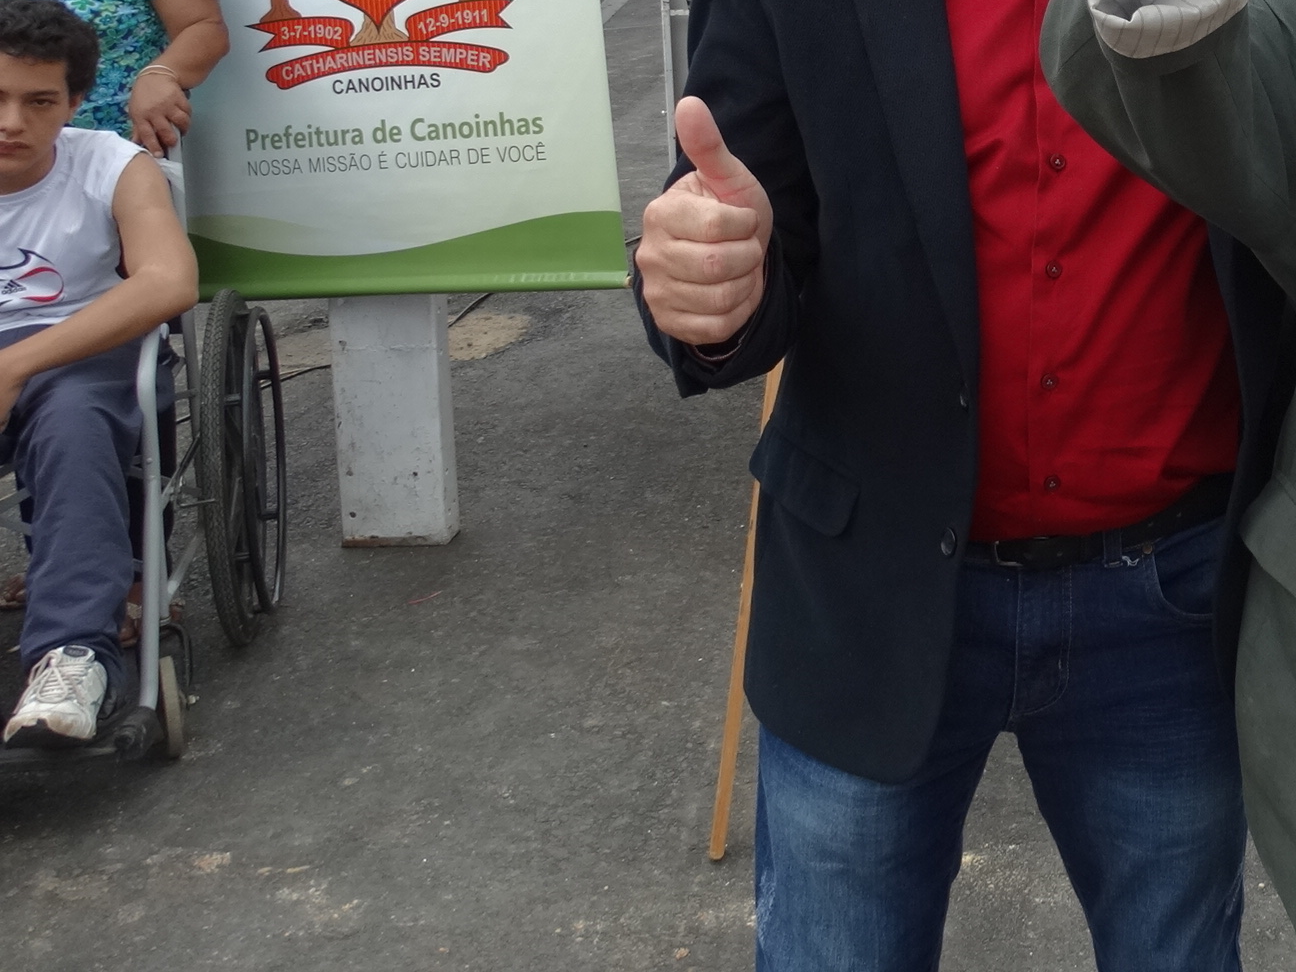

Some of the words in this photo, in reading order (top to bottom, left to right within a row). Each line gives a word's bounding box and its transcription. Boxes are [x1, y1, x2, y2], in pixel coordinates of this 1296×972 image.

[280, 24, 343, 40] 3-7-1902
[418, 9, 489, 34] 12-9-1911
[281, 46, 414, 81] CATHARINENSIS
[419, 46, 492, 68] SEMPER
[332, 72, 442, 95] CANOINHAS
[245, 124, 365, 152] Prefeitura
[372, 119, 402, 144] de
[410, 111, 545, 142] Canoinhas
[247, 158, 304, 177] NOSSA
[308, 152, 372, 173] MISSÃO
[378, 151, 389, 170] É
[395, 149, 462, 169] CUIDAR
[467, 147, 492, 165] DE
[496, 141, 547, 163] VOCÊ
